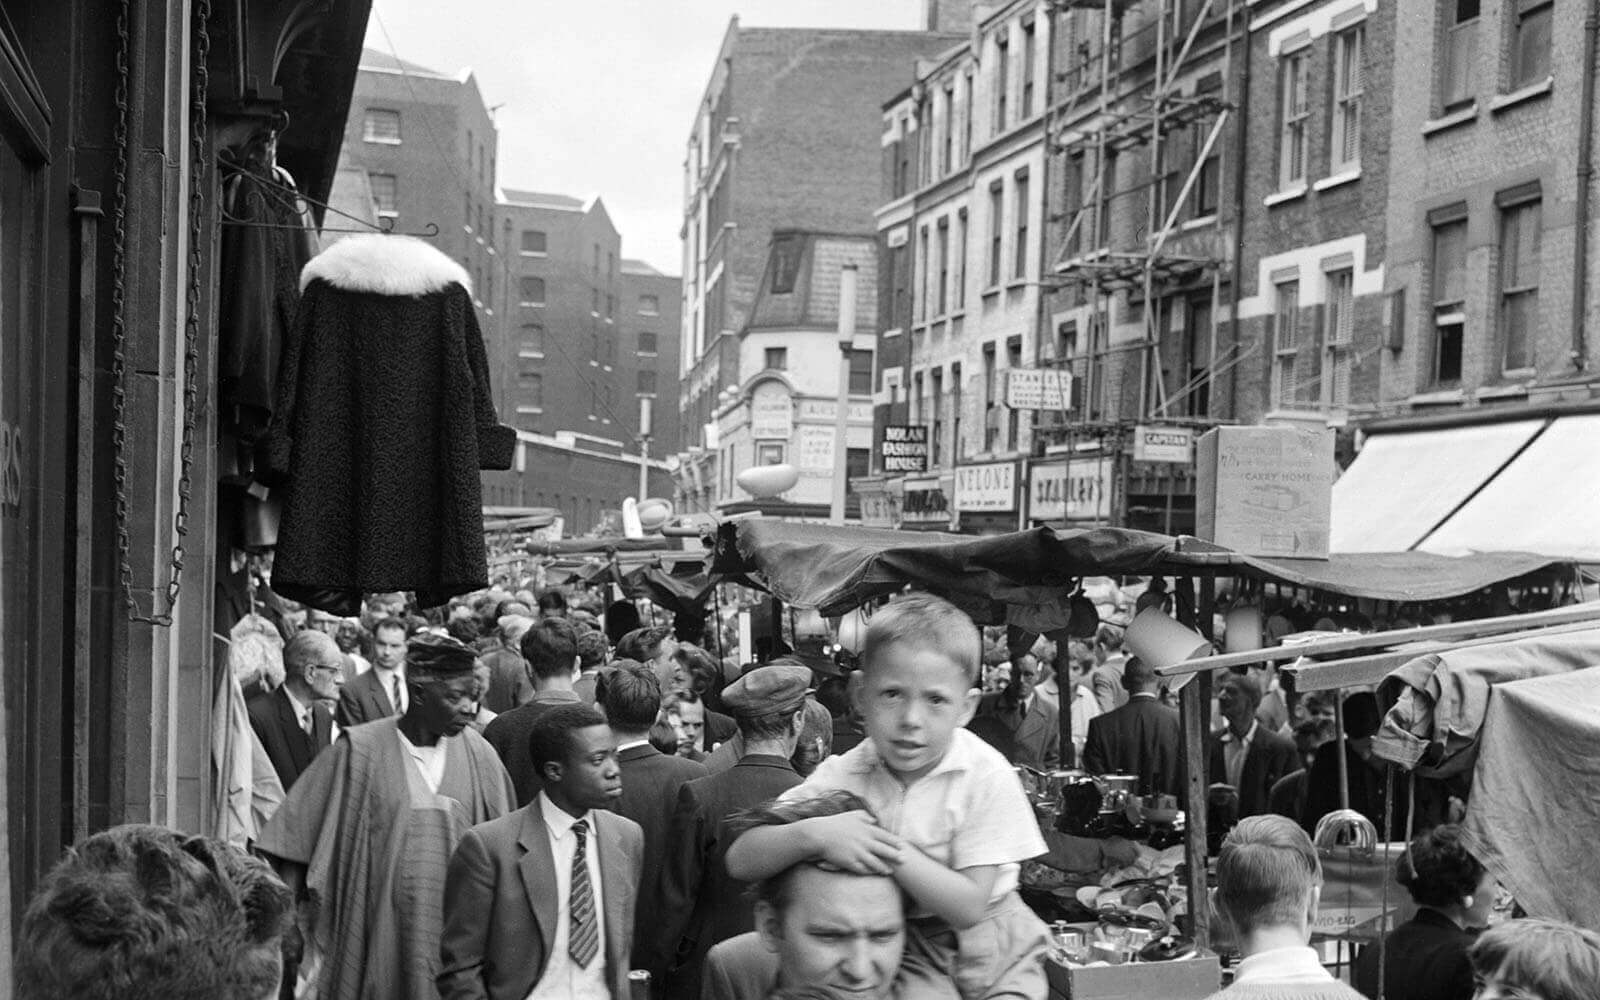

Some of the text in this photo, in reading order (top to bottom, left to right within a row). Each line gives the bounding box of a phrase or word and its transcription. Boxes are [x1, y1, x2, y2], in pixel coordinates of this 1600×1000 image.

[886, 427, 925, 441] NOLAN
[882, 442, 928, 456] FASHION
[885, 457, 925, 471] HOUSE
[958, 467, 1010, 491] NELONE
[1244, 472, 1278, 481] CARRY
[1281, 472, 1311, 481] HOME
